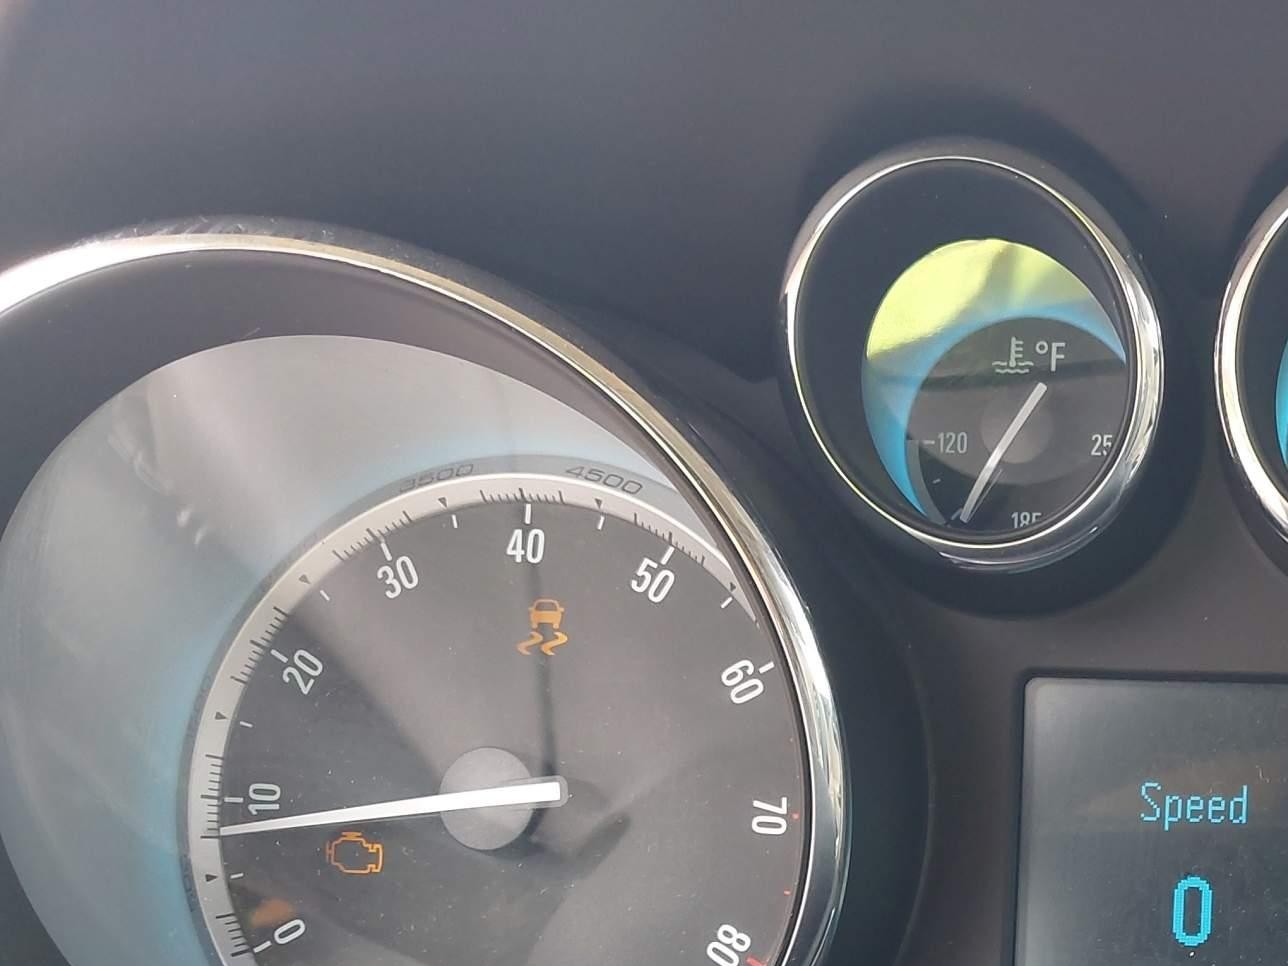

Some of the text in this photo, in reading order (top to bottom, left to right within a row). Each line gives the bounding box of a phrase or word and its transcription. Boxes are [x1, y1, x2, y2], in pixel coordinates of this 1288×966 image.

[937, 432, 969, 455] 120
[565, 466, 643, 496] 4500
[505, 527, 546, 564] 40
[375, 555, 420, 601] 30
[629, 556, 676, 605] 50
[282, 647, 325, 696] 20
[718, 657, 765, 706] 60
[247, 781, 282, 816] 10
[750, 795, 788, 836] 70
[1140, 781, 1248, 831] Speed
[273, 918, 308, 945] 0
[1172, 876, 1214, 948] 0
